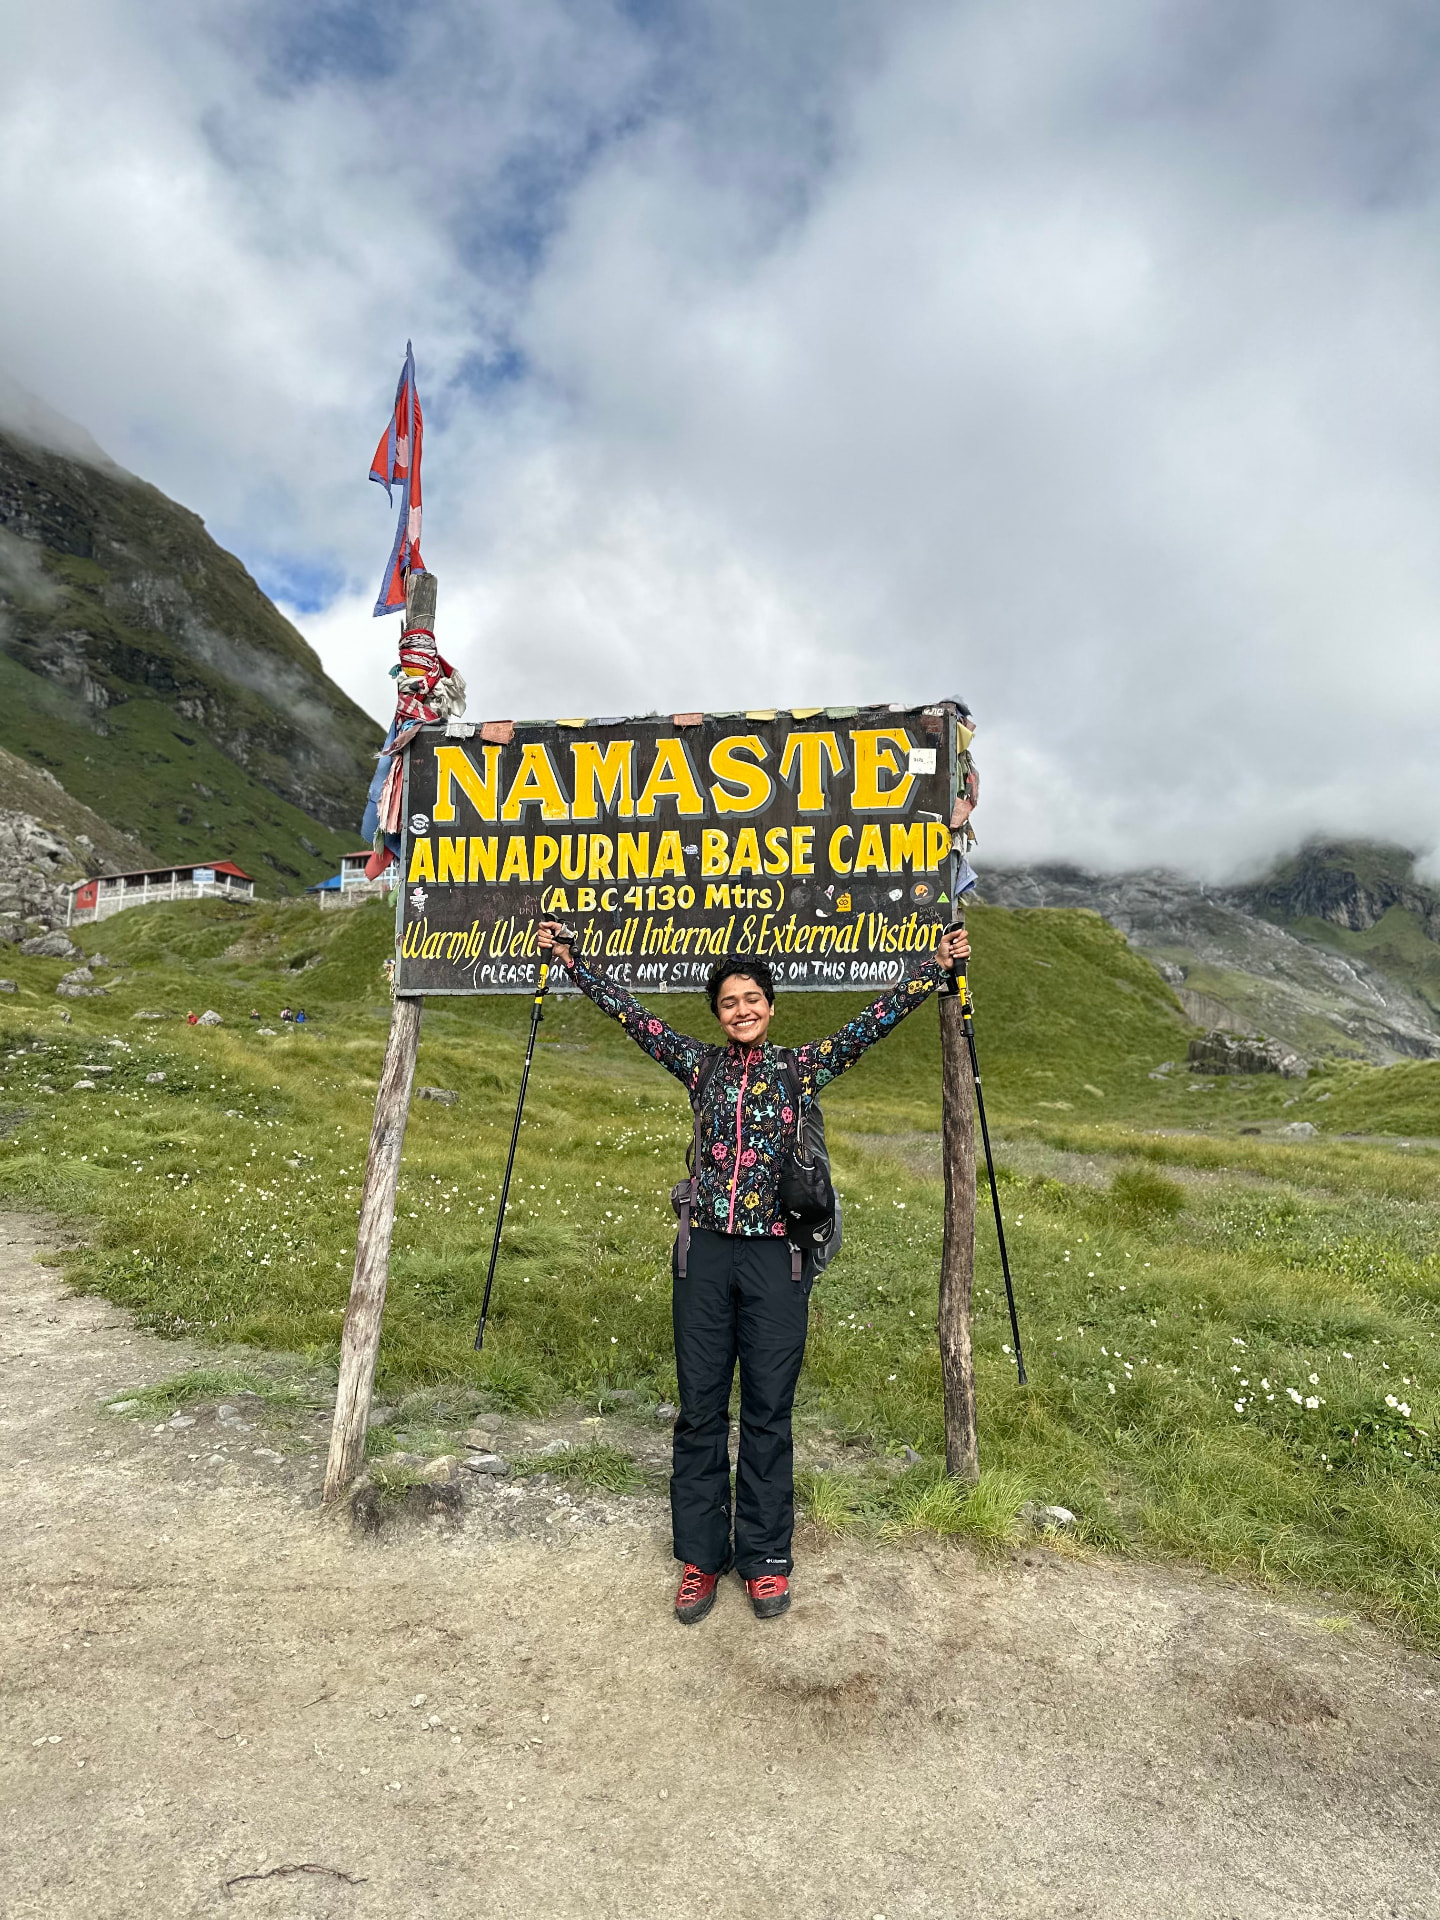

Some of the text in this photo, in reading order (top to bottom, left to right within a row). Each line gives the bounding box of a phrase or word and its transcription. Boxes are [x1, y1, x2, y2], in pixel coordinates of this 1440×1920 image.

[432, 728, 920, 823] NAMASTE
[407, 822, 952, 884] ANNAPURNA BASE CAMP
[703, 880, 785, 912] Mtrs)
[402, 916, 487, 970] Warmly
[580, 918, 603, 957] to
[605, 917, 638, 957] all
[640, 912, 736, 957] Internal
[473, 961, 536, 989] (PLEASE
[636, 962, 669, 981] ANY
[811, 960, 846, 981] THIS
[850, 957, 905, 982] BOARD)
